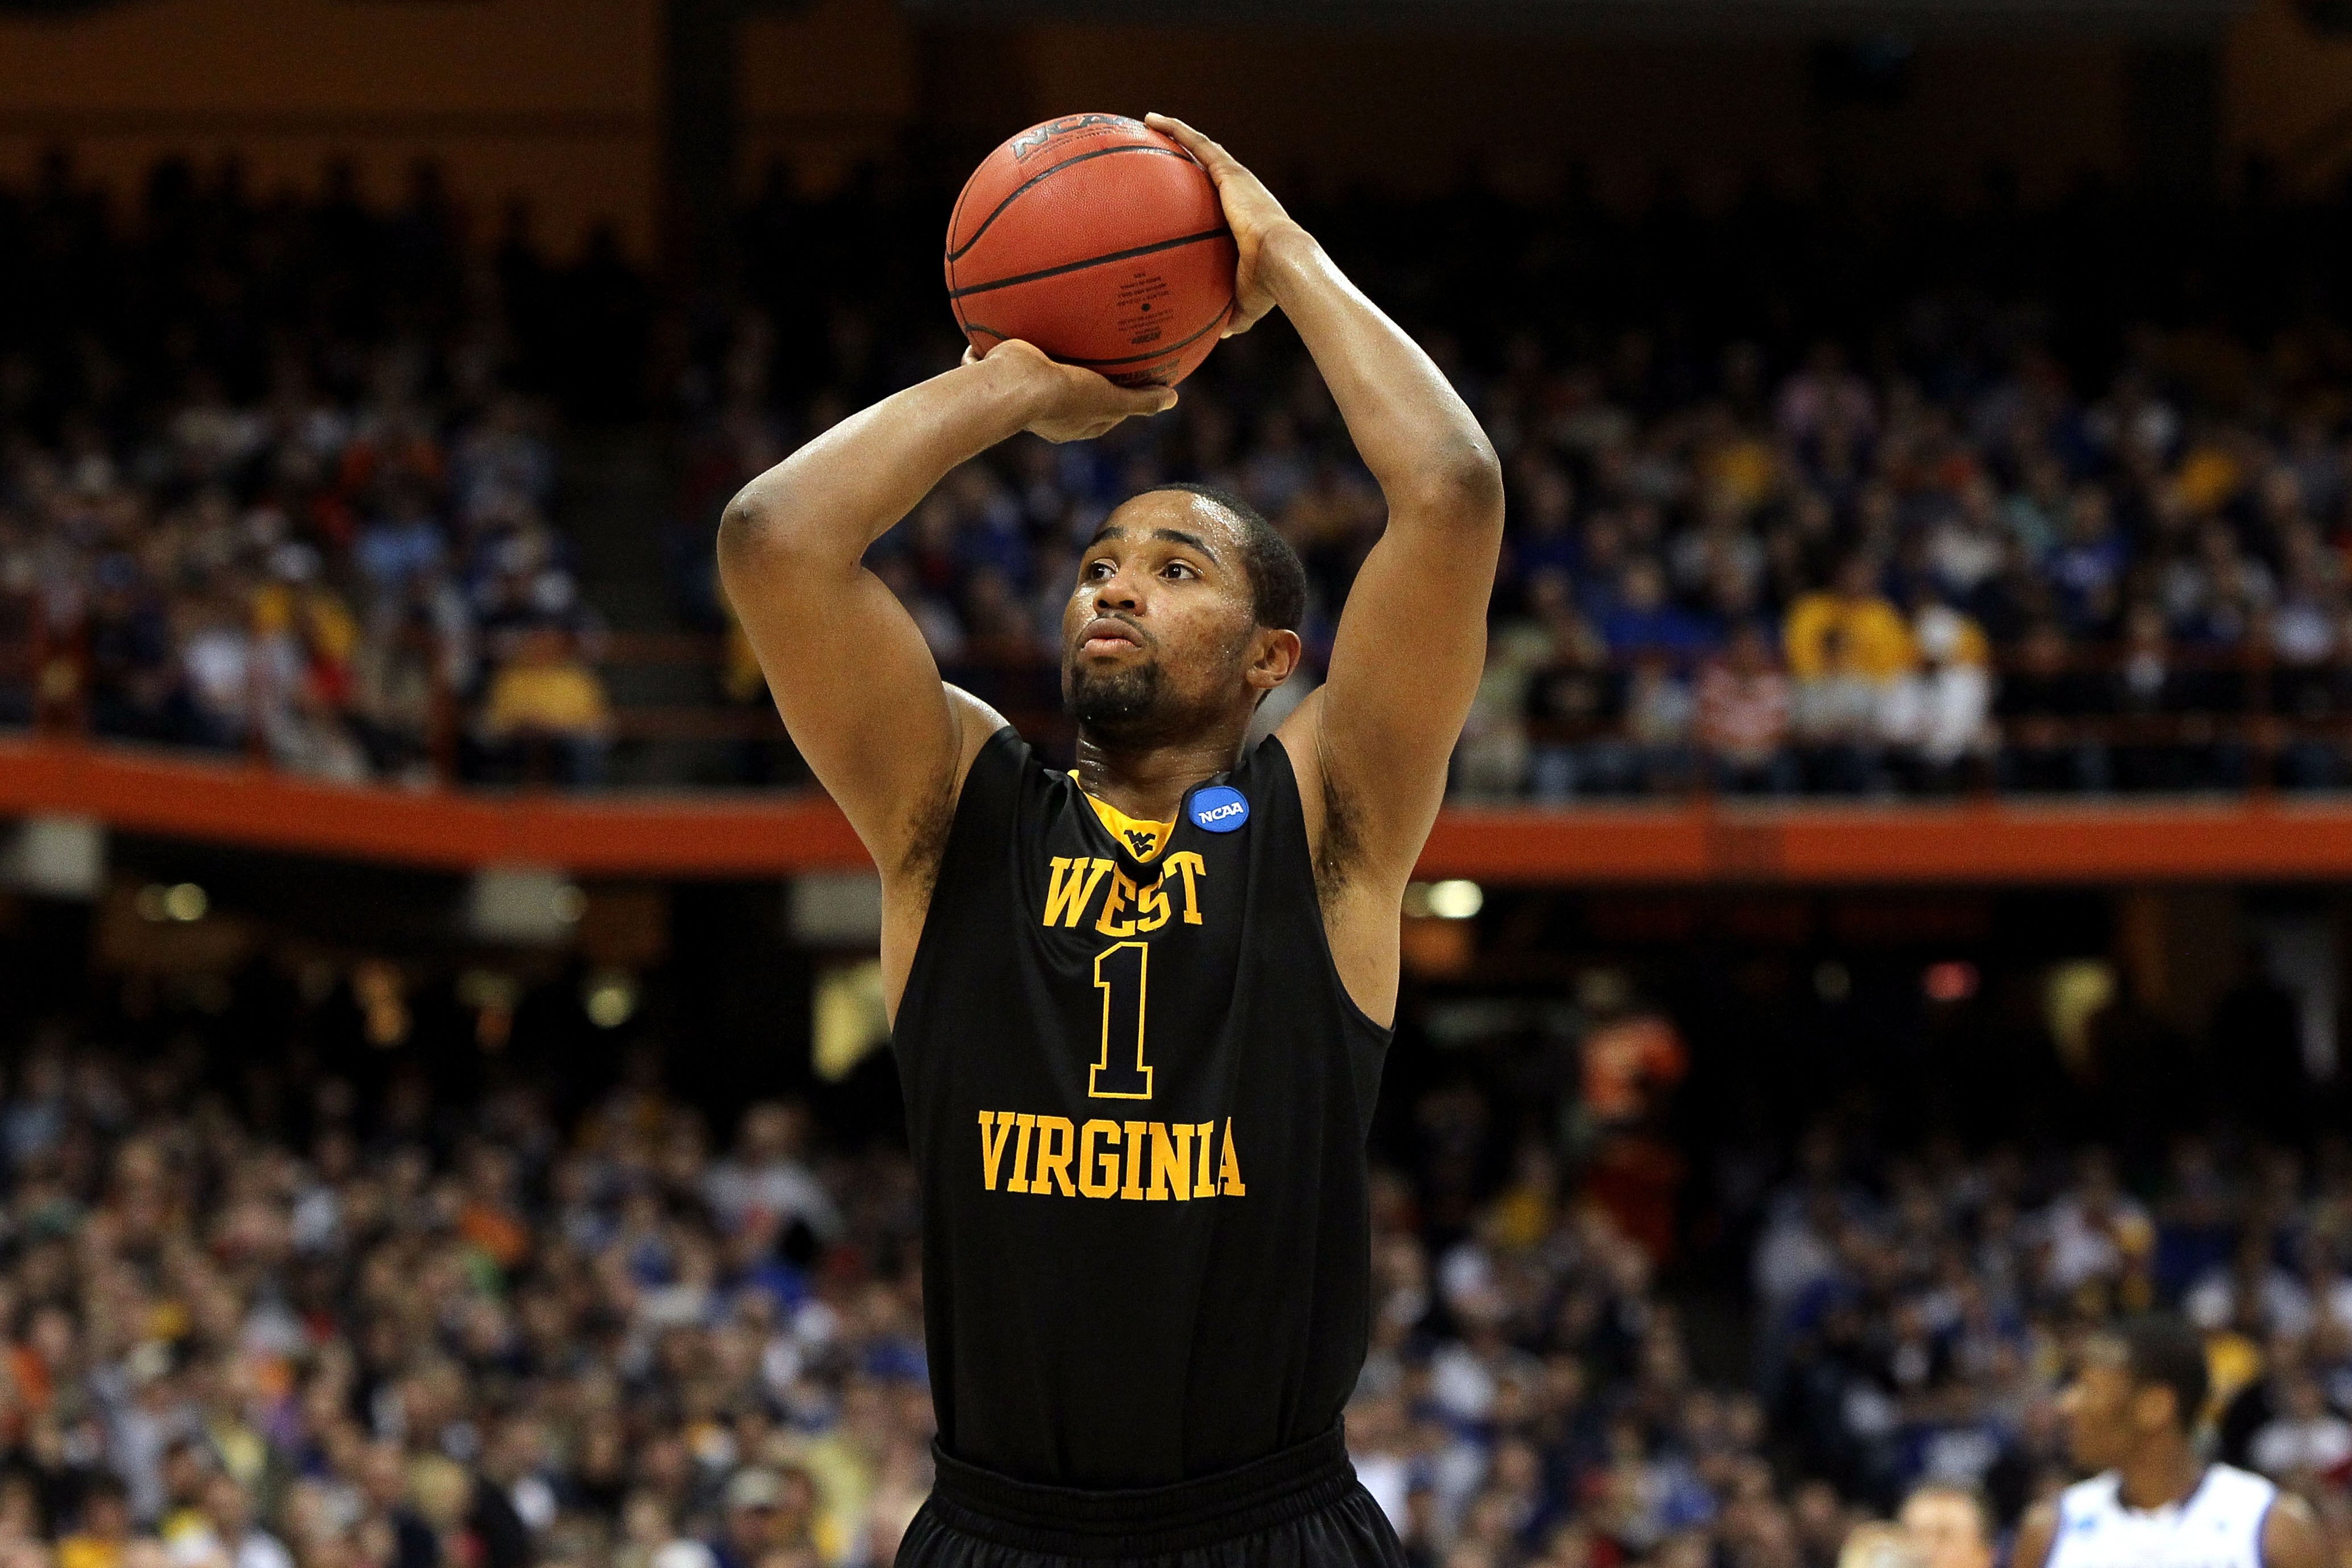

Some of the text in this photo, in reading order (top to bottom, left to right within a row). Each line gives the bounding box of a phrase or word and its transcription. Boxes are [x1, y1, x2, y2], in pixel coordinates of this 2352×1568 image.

[1198, 802, 1244, 823] NCAA
[1043, 851, 1206, 937] WEST
[1088, 942, 1152, 1100] 1
[978, 1111, 1245, 1201] VIRGINIA
